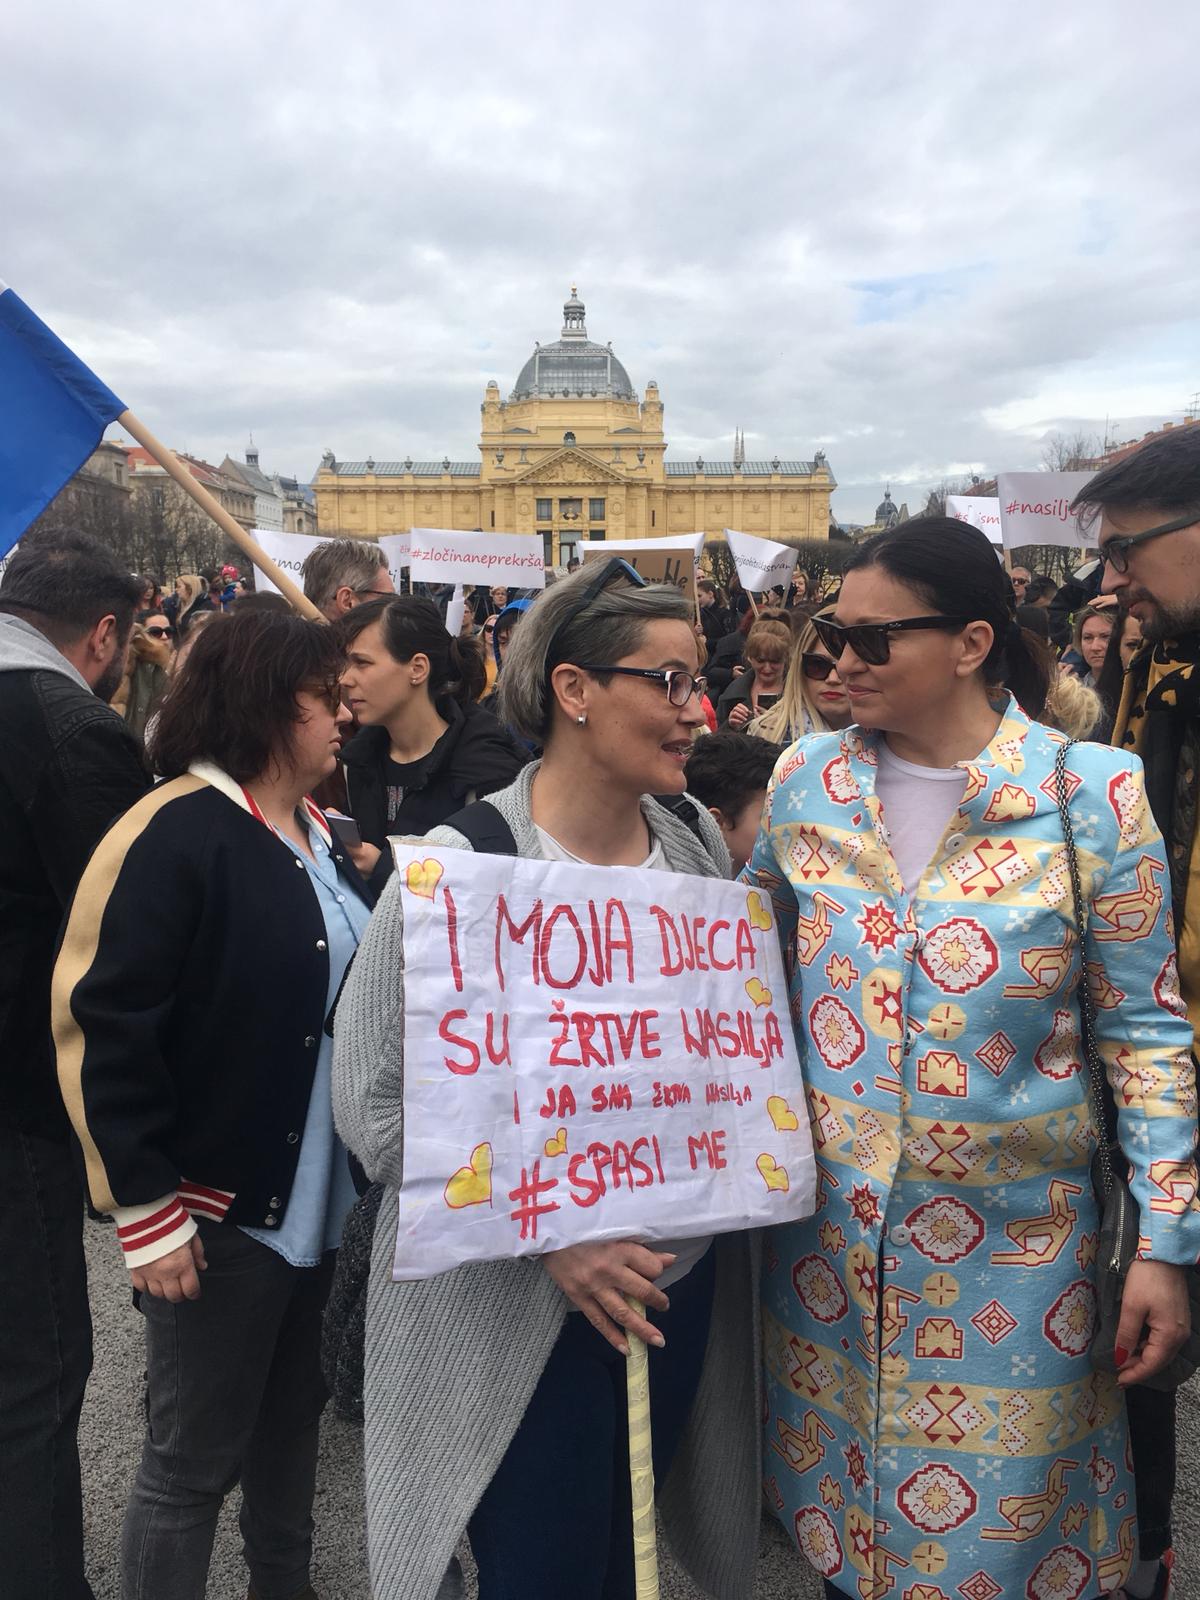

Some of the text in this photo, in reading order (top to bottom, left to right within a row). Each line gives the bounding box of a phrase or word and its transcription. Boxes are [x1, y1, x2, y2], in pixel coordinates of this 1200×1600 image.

[443, 885, 757, 992] I MOJA DJECA
[438, 999, 784, 1075] SU ŽRTVE NASILJA
[513, 1089, 521, 1125] I
[540, 1084, 577, 1119] JA
[592, 1083, 633, 1113] SAM
[508, 1130, 728, 1240] #SPASI ME
